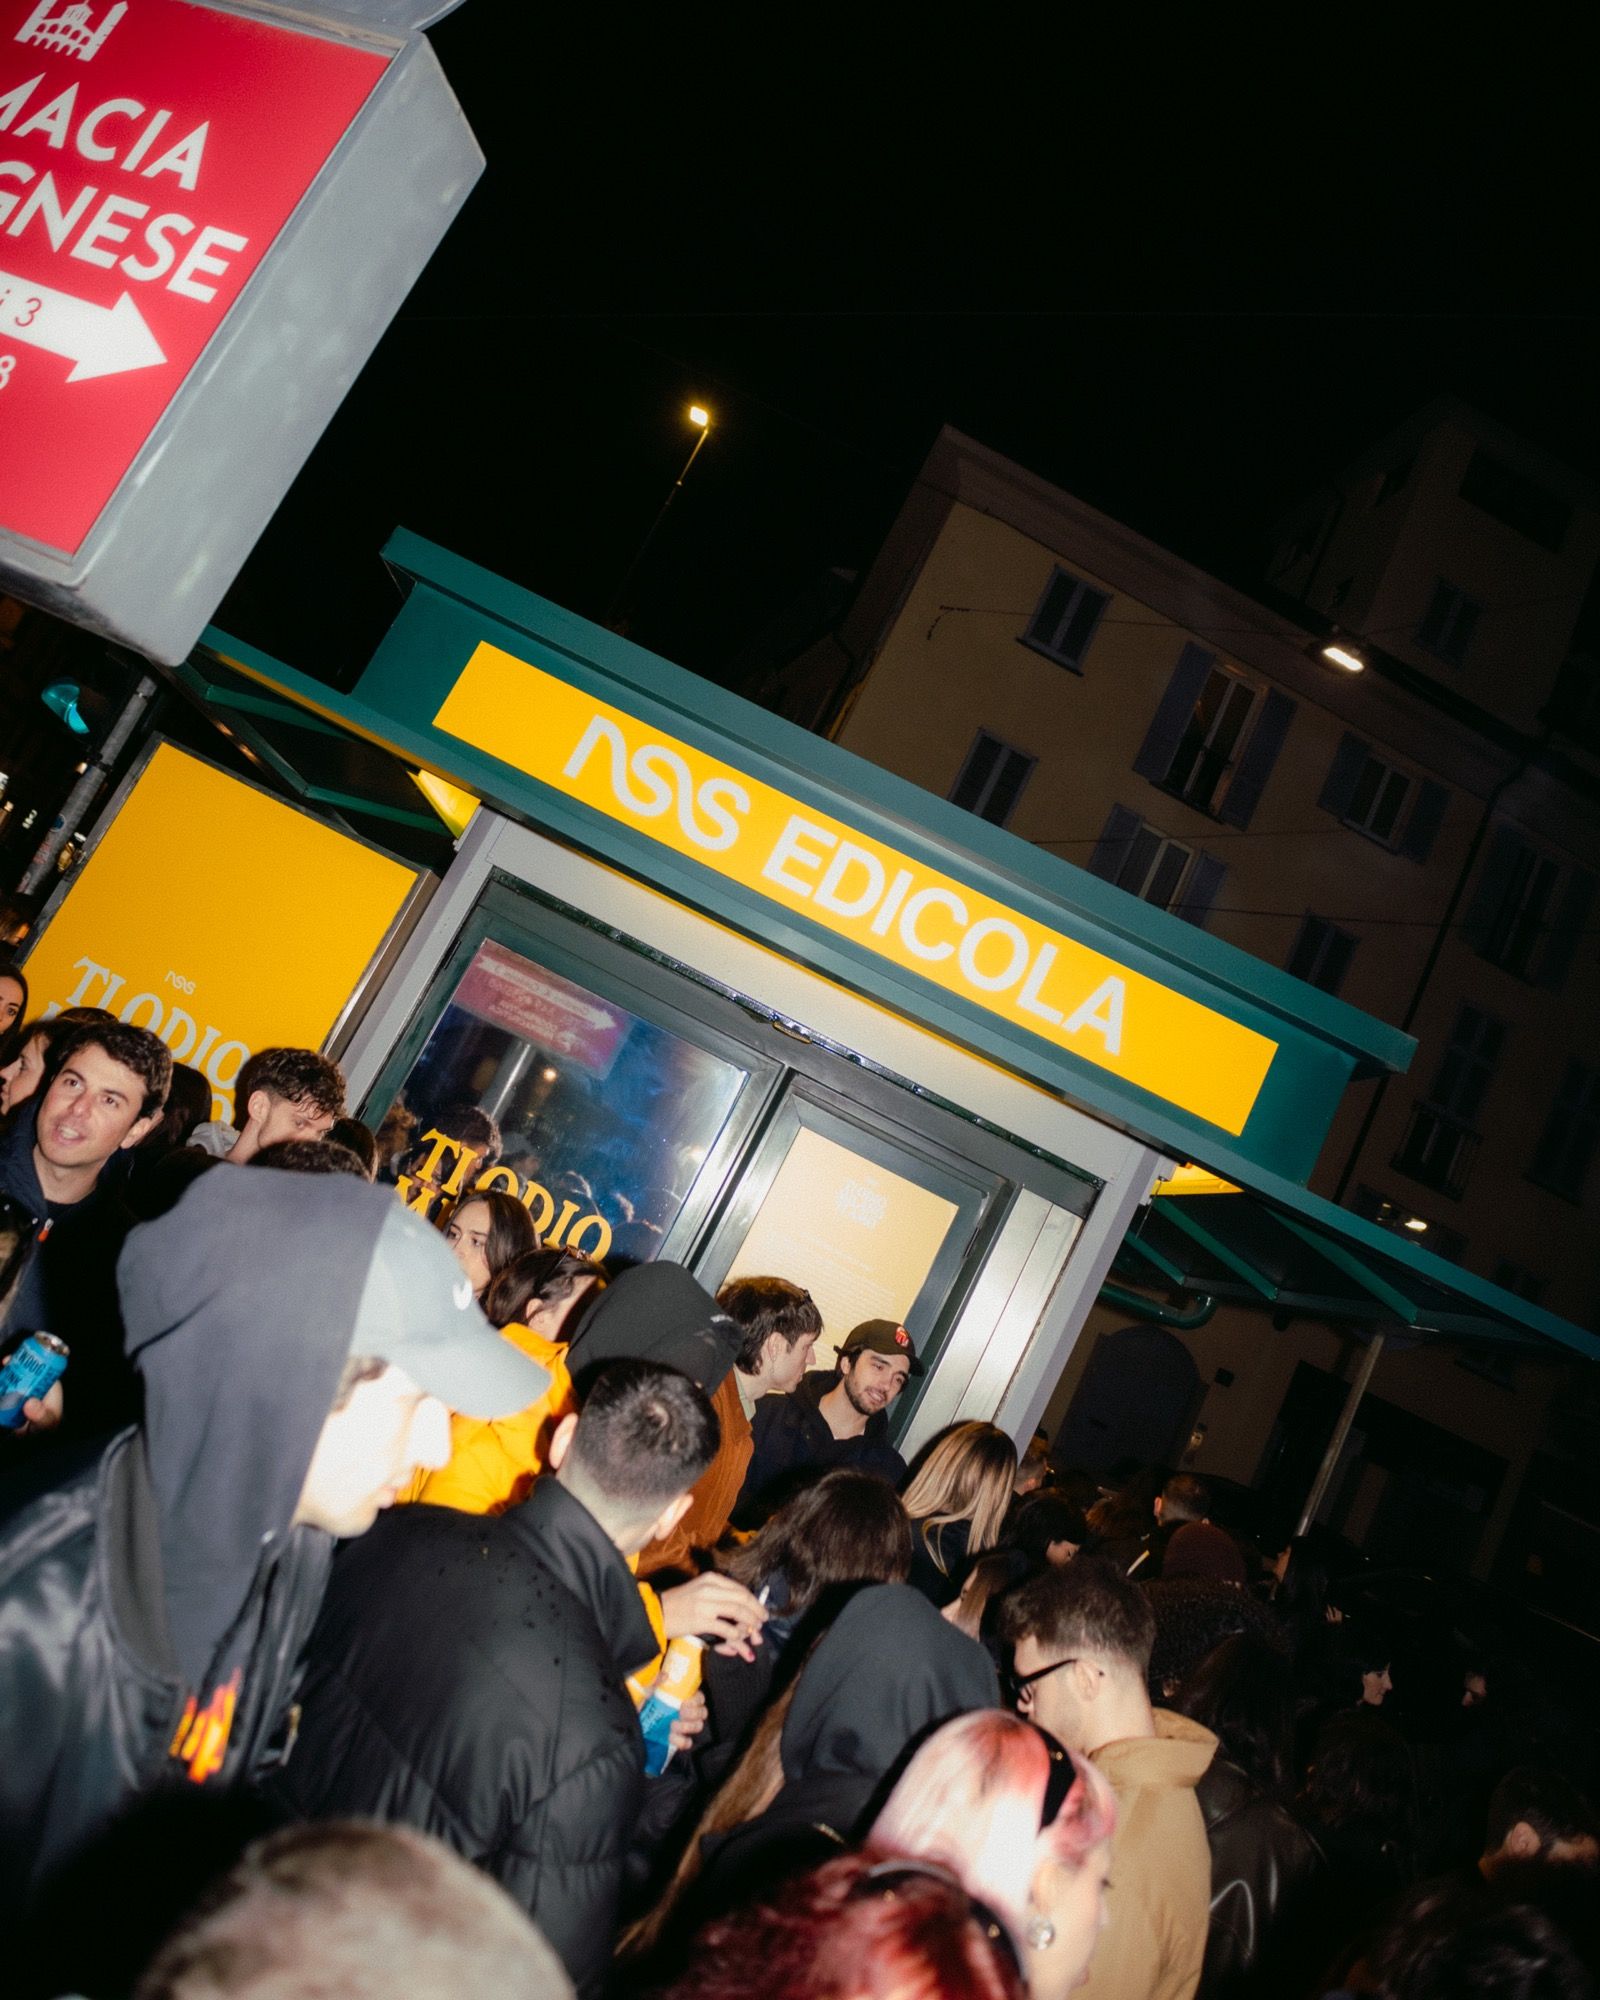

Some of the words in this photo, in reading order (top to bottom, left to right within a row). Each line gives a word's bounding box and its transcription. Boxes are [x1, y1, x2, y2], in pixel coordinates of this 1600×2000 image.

[760, 814, 1128, 1057] EDICOLA
[66, 955, 127, 1009] TI
[117, 992, 252, 1090] ODIO
[415, 1127, 479, 1196] TI
